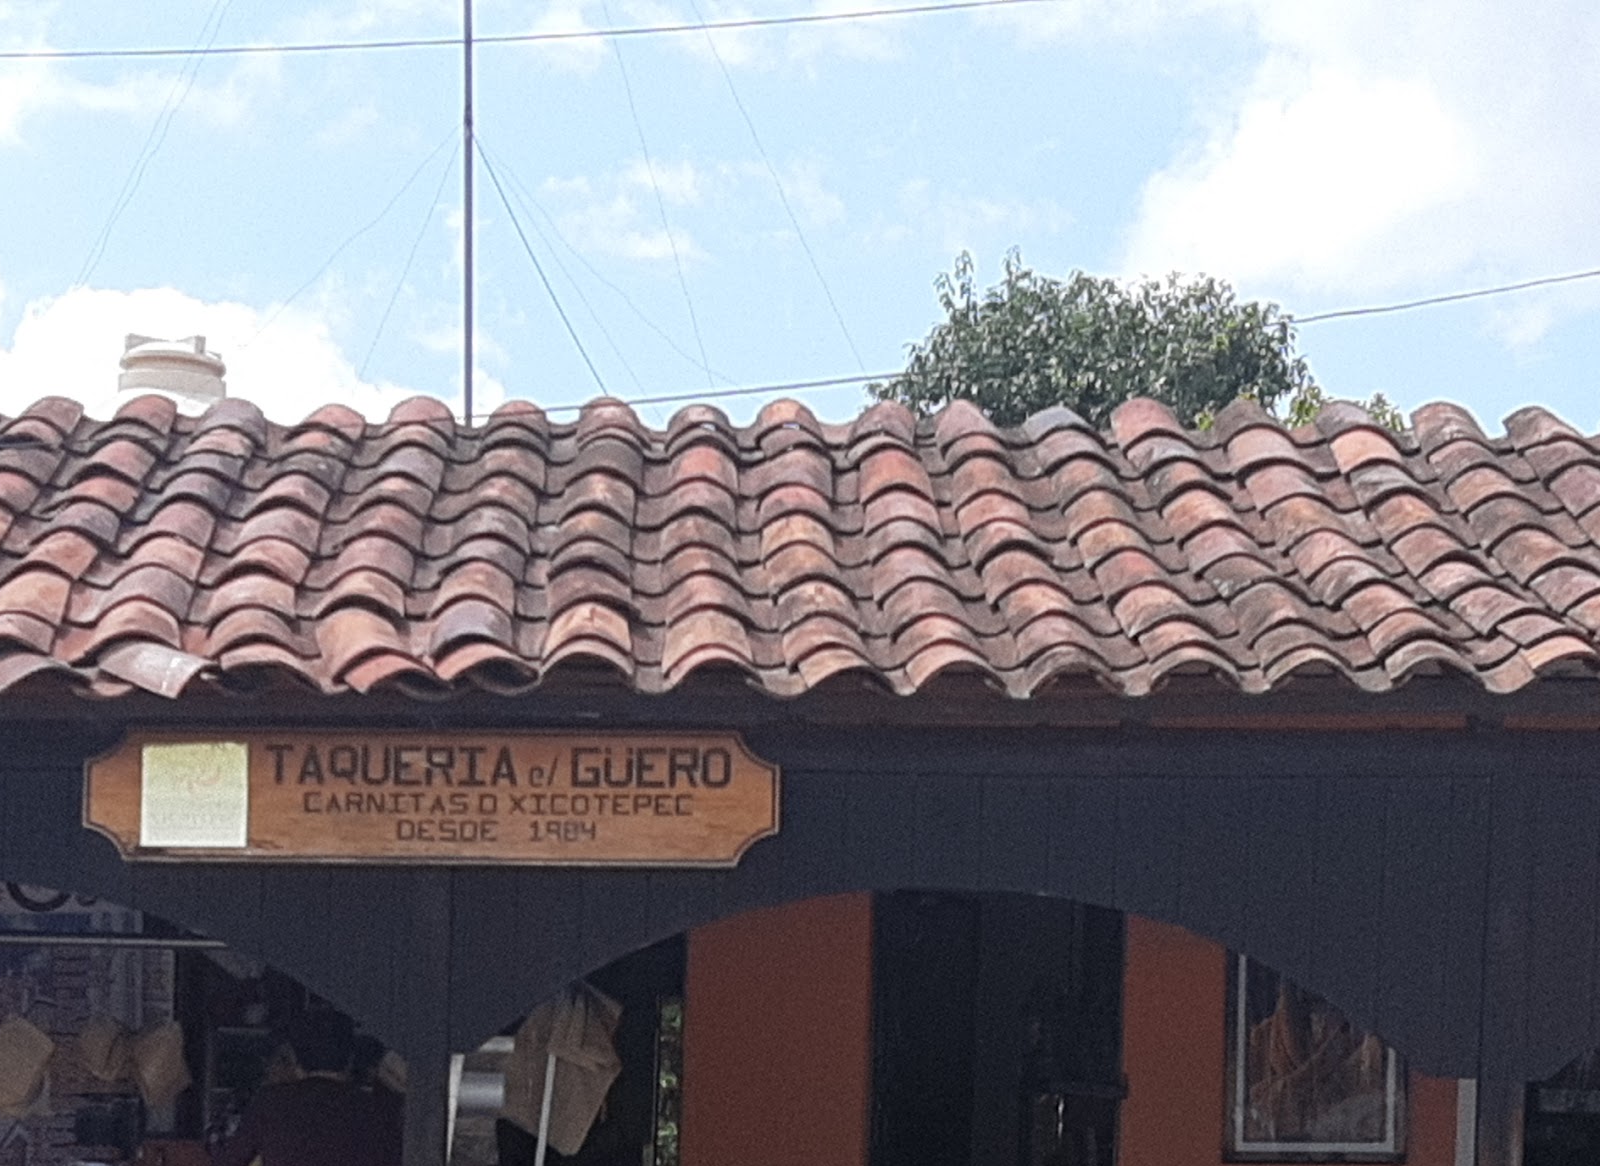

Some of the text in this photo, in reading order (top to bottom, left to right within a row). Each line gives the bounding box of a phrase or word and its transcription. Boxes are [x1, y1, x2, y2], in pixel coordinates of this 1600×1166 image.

[266, 743, 518, 787] TAQUERIA
[570, 746, 733, 789] GÜERO
[303, 791, 469, 816] CARNITAS
[508, 793, 694, 817] XICOTEPEC
[395, 818, 597, 843] DESDE 1984
